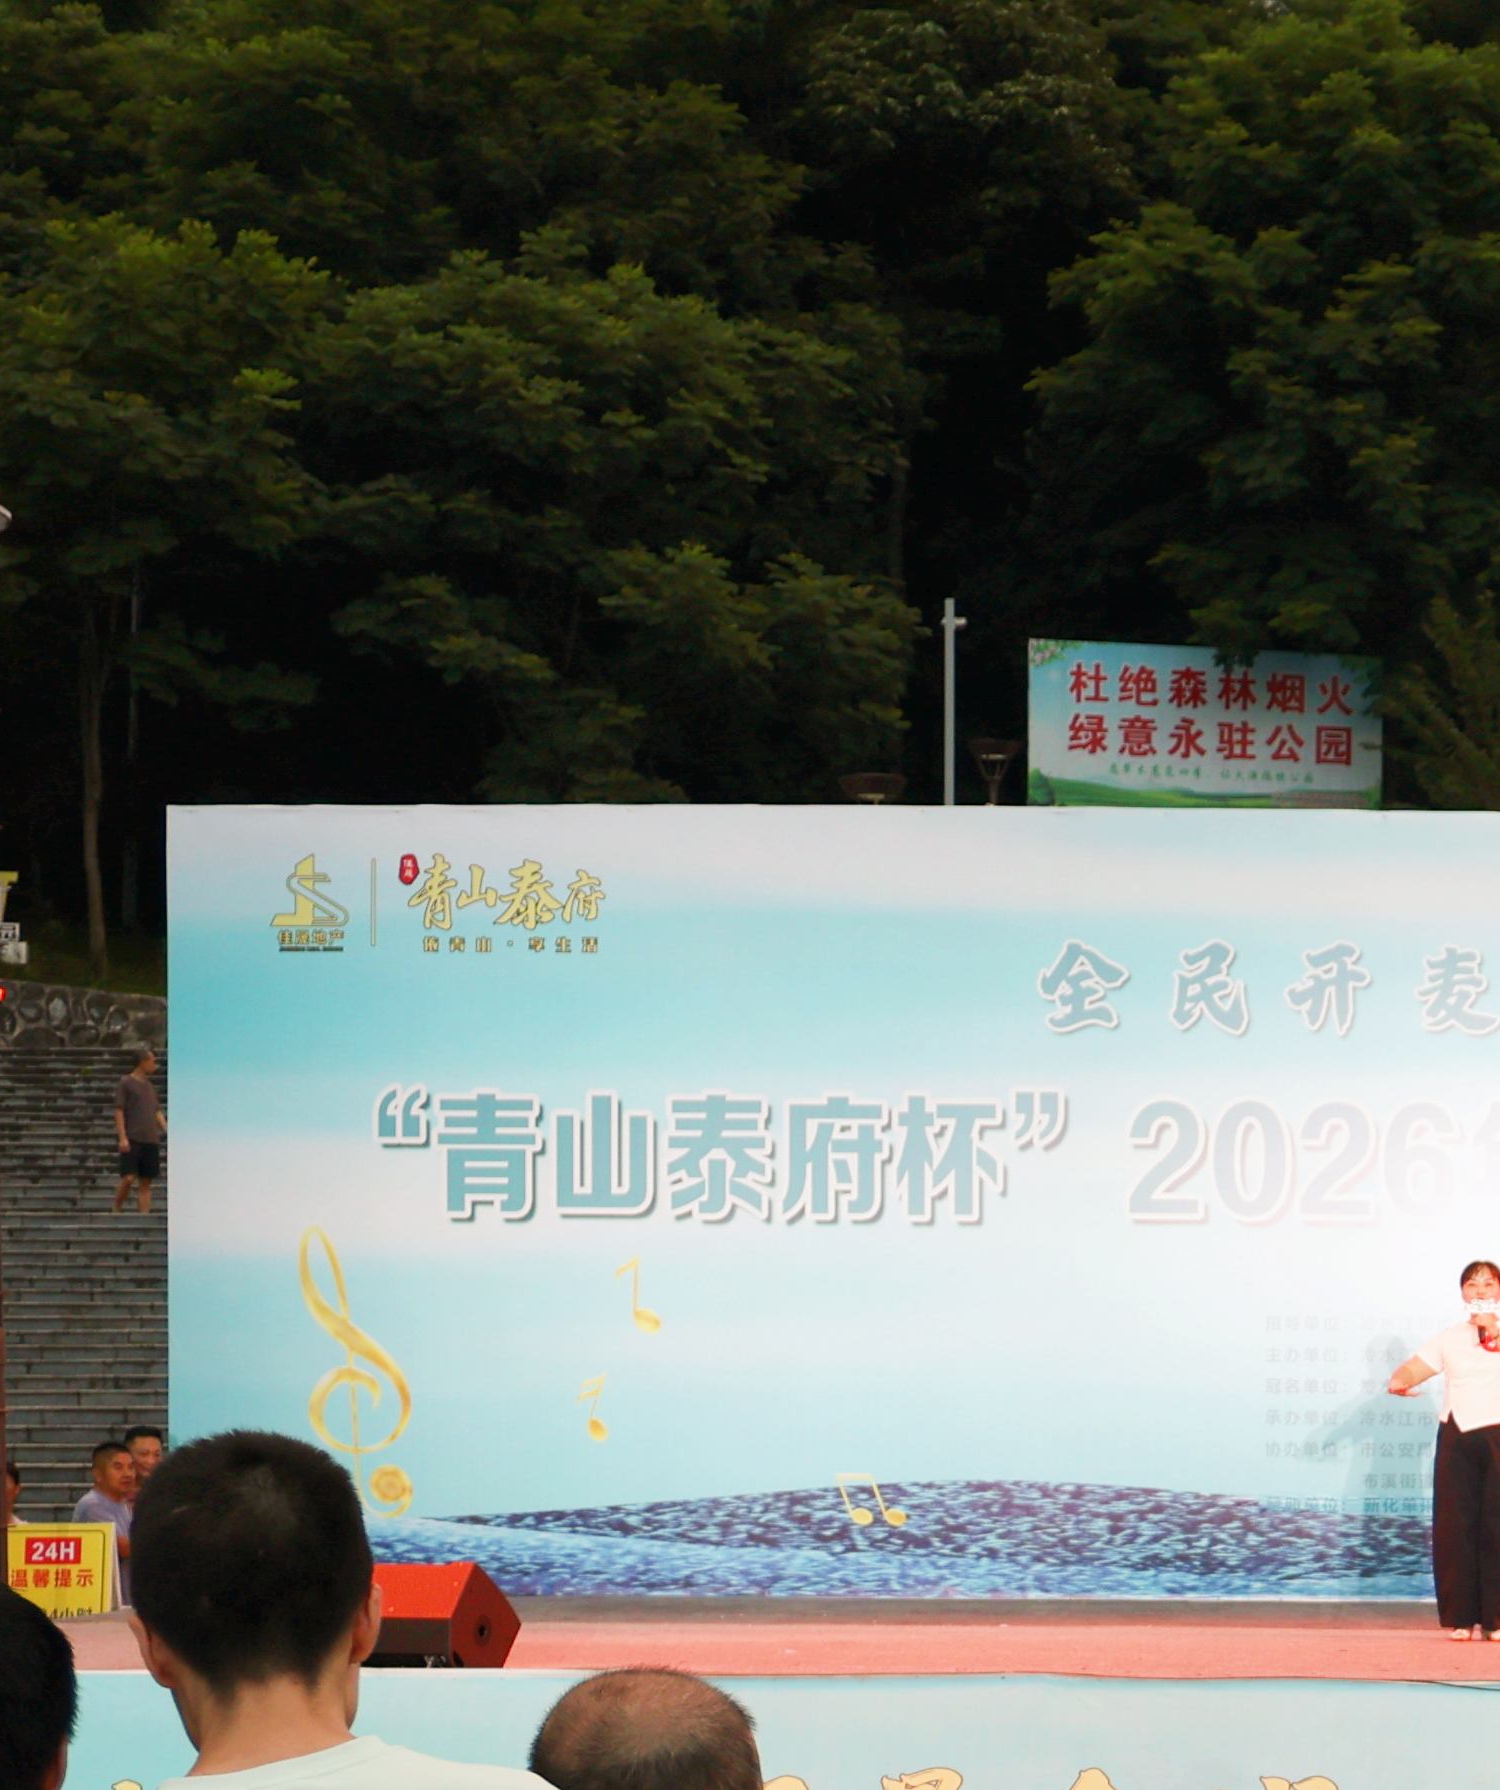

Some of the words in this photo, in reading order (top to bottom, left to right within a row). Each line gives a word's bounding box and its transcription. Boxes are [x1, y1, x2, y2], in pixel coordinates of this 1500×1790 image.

[1068, 662, 1354, 716] 杜绝森林烟火
[1067, 713, 1354, 766] 绿意永驻公园
[408, 853, 605, 930] 青山泰府
[31, 1541, 75, 1561] 24H
[11, 1568, 94, 1588] 温馨提示
